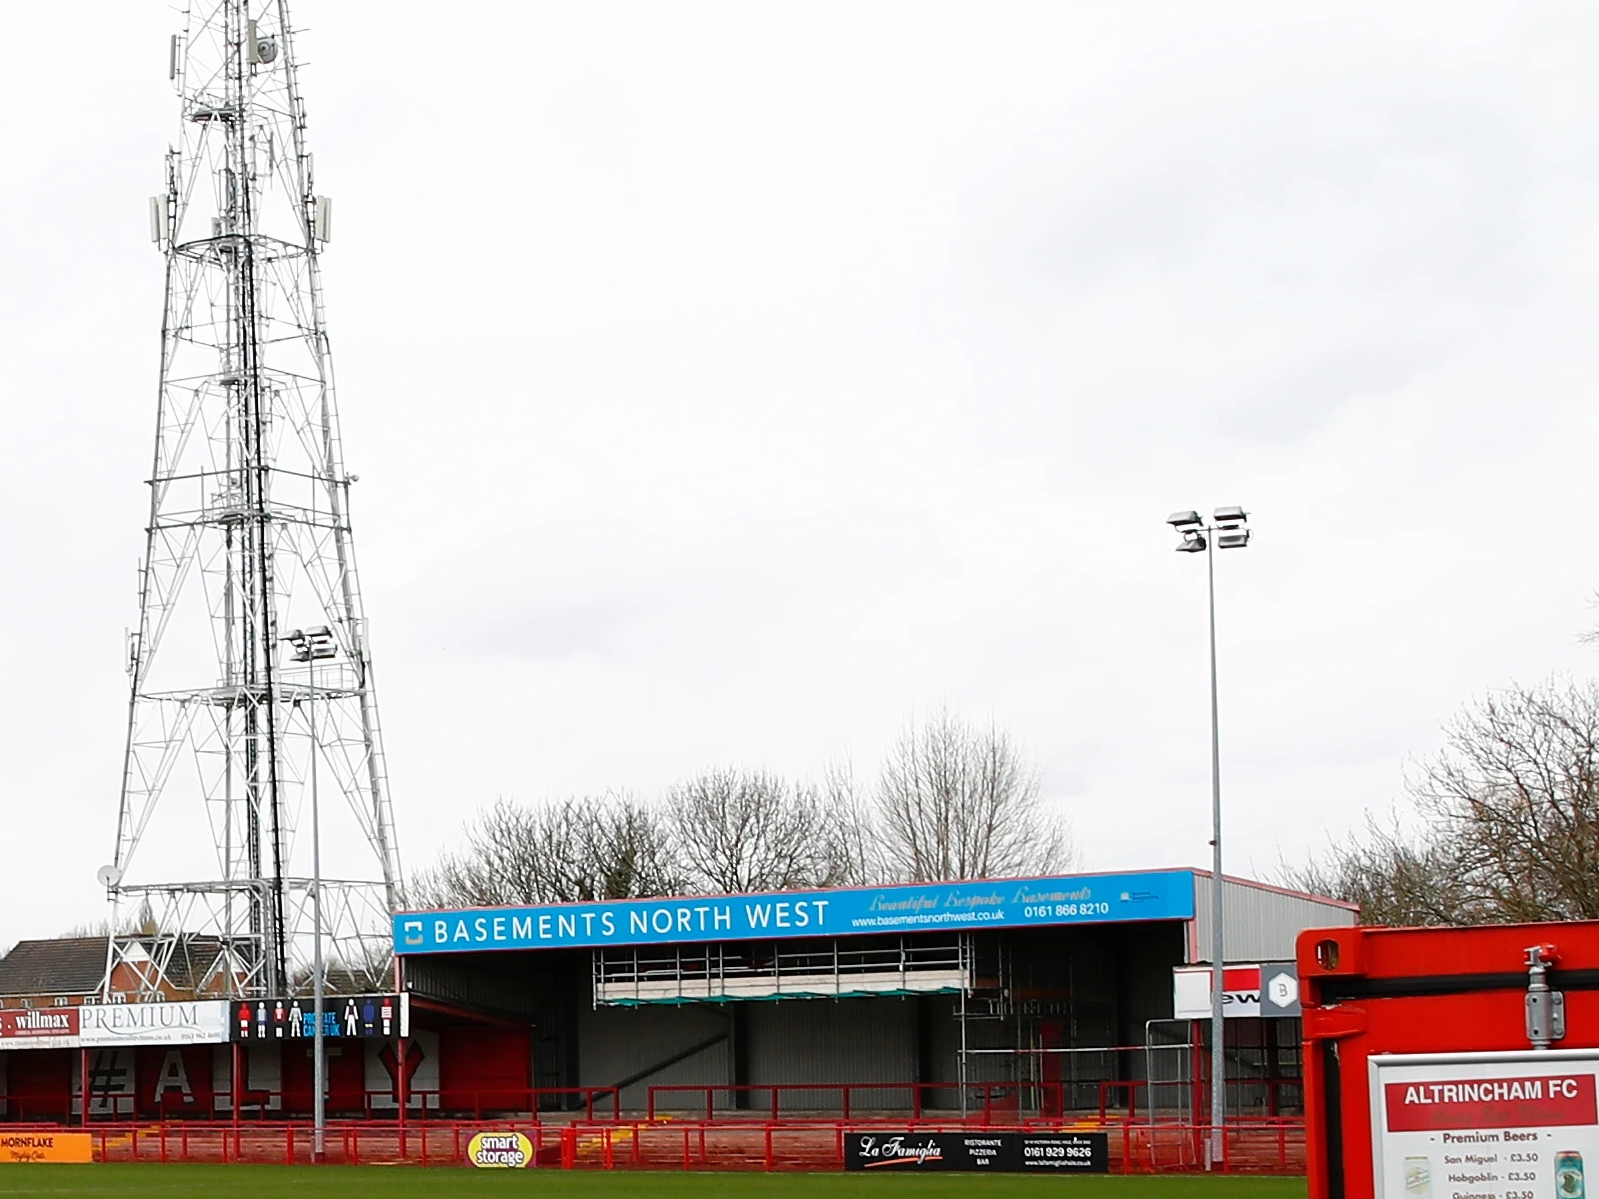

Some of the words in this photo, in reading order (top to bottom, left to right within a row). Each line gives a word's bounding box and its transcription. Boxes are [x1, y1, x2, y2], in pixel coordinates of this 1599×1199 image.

[851, 910, 1005, 927] www.basementsnorthwest.co.uk
[1024, 905, 1053, 918] 0161
[1056, 903, 1078, 917] 866
[1080, 902, 1109, 916] 8210
[434, 912, 615, 943] BASEMENTS
[630, 905, 731, 934] NORTH
[745, 901, 829, 928] WEST
[15, 1011, 69, 1029] willmax
[81, 1004, 199, 1029] PREMIUM
[1404, 1082, 1542, 1105] ALTRINCHAM
[1549, 1079, 1578, 1099] FC
[1, 1137, 54, 1148] MORNFLAKE
[481, 1135, 519, 1152] smart
[964, 1139, 1002, 1147] RISTORANTE
[1443, 1132, 1500, 1144] Premium
[1503, 1131, 1538, 1143] Beers
[476, 1149, 524, 1168] storage
[859, 1136, 879, 1158] La
[881, 1137, 942, 1164] Famiglia
[1024, 1147, 1044, 1157] 0161
[1045, 1147, 1065, 1157] 929
[1066, 1147, 1092, 1157] 9626
[1444, 1155, 1462, 1164] San
[1465, 1154, 1498, 1166] Miguel
[1510, 1153, 1539, 1163] £3.50
[1448, 1172, 1499, 1184] Hobgoblin
[1508, 1172, 1536, 1182] £3.50
